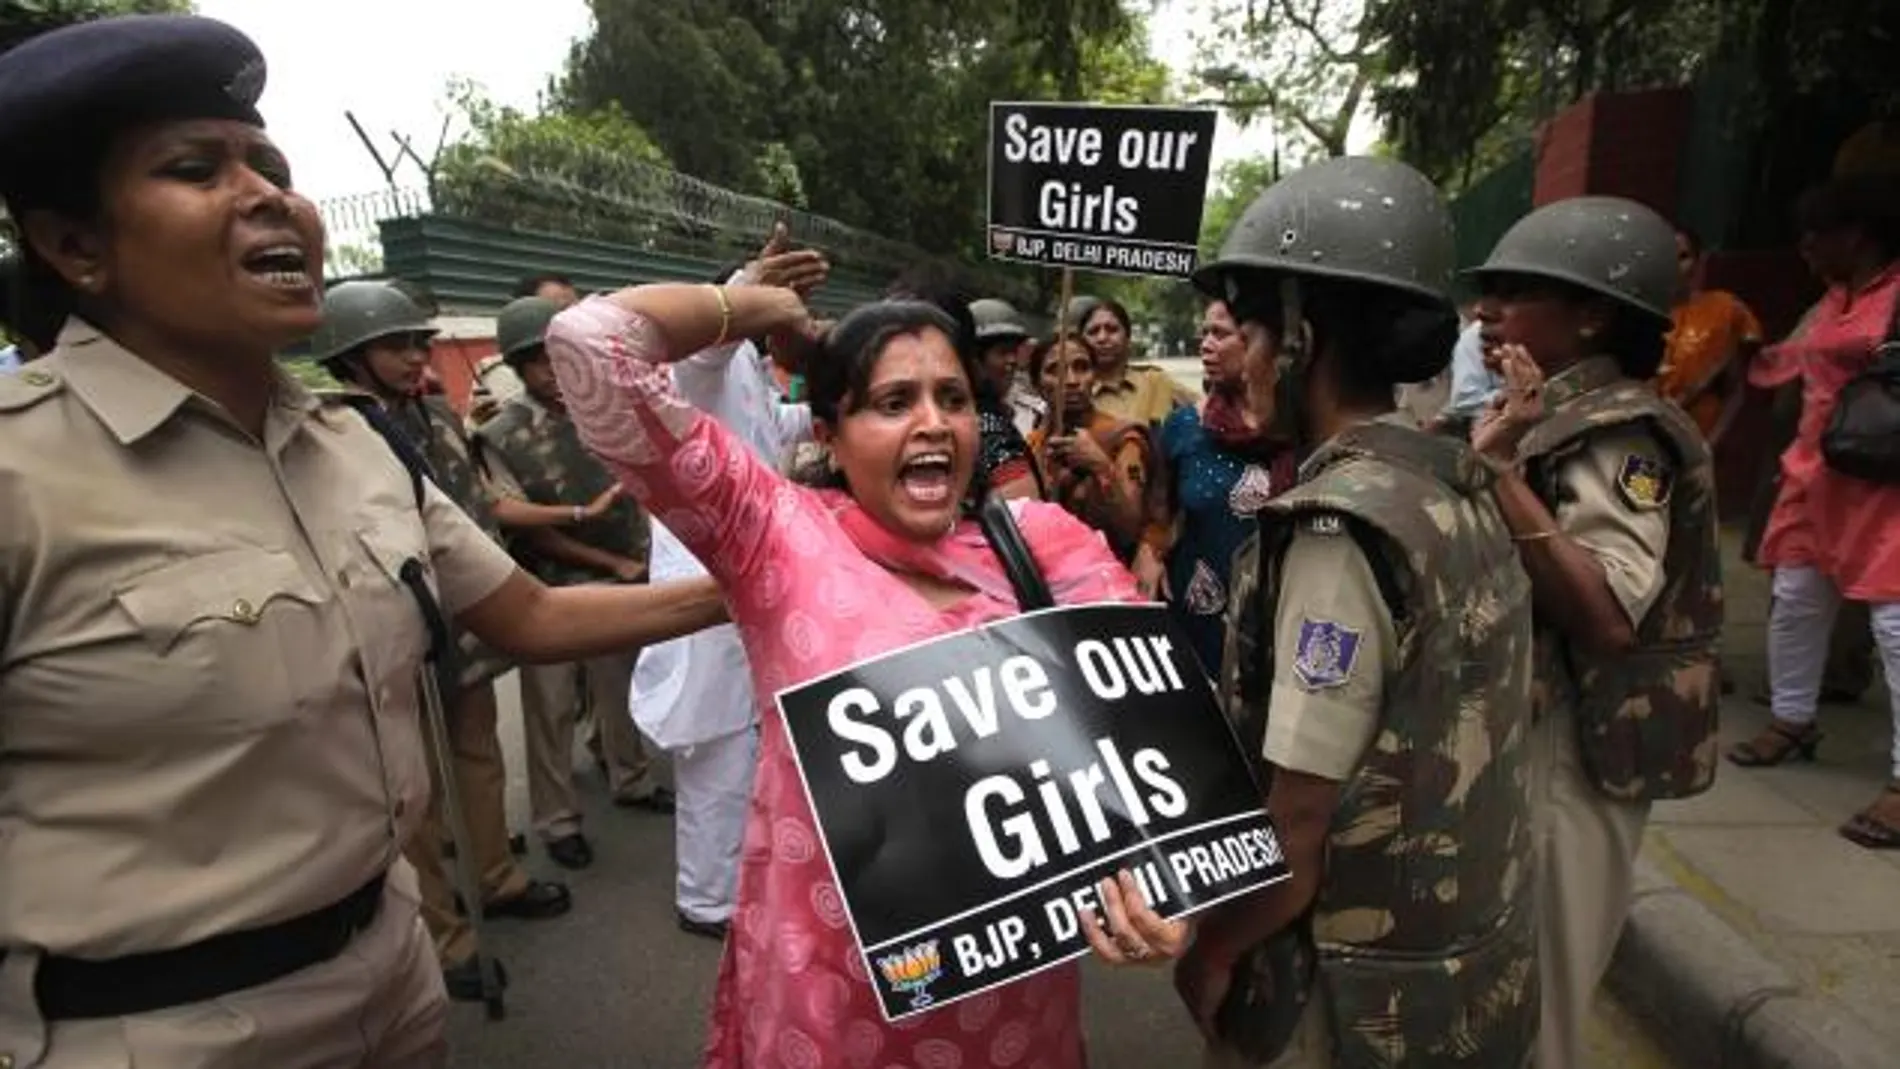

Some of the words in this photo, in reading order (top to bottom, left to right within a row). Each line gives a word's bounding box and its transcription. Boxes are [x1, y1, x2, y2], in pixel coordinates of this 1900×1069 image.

[1004, 112, 1102, 166] Save
[1118, 128, 1198, 171] our
[1039, 180, 1139, 235] Girls
[1016, 235, 1047, 261] BJP,
[1052, 241, 1101, 263] DELHI
[1105, 246, 1192, 273] PRADESH
[826, 654, 1058, 785] Save
[1075, 633, 1186, 701] our
[964, 737, 1189, 880] Girls
[953, 914, 1042, 979] BJP,
